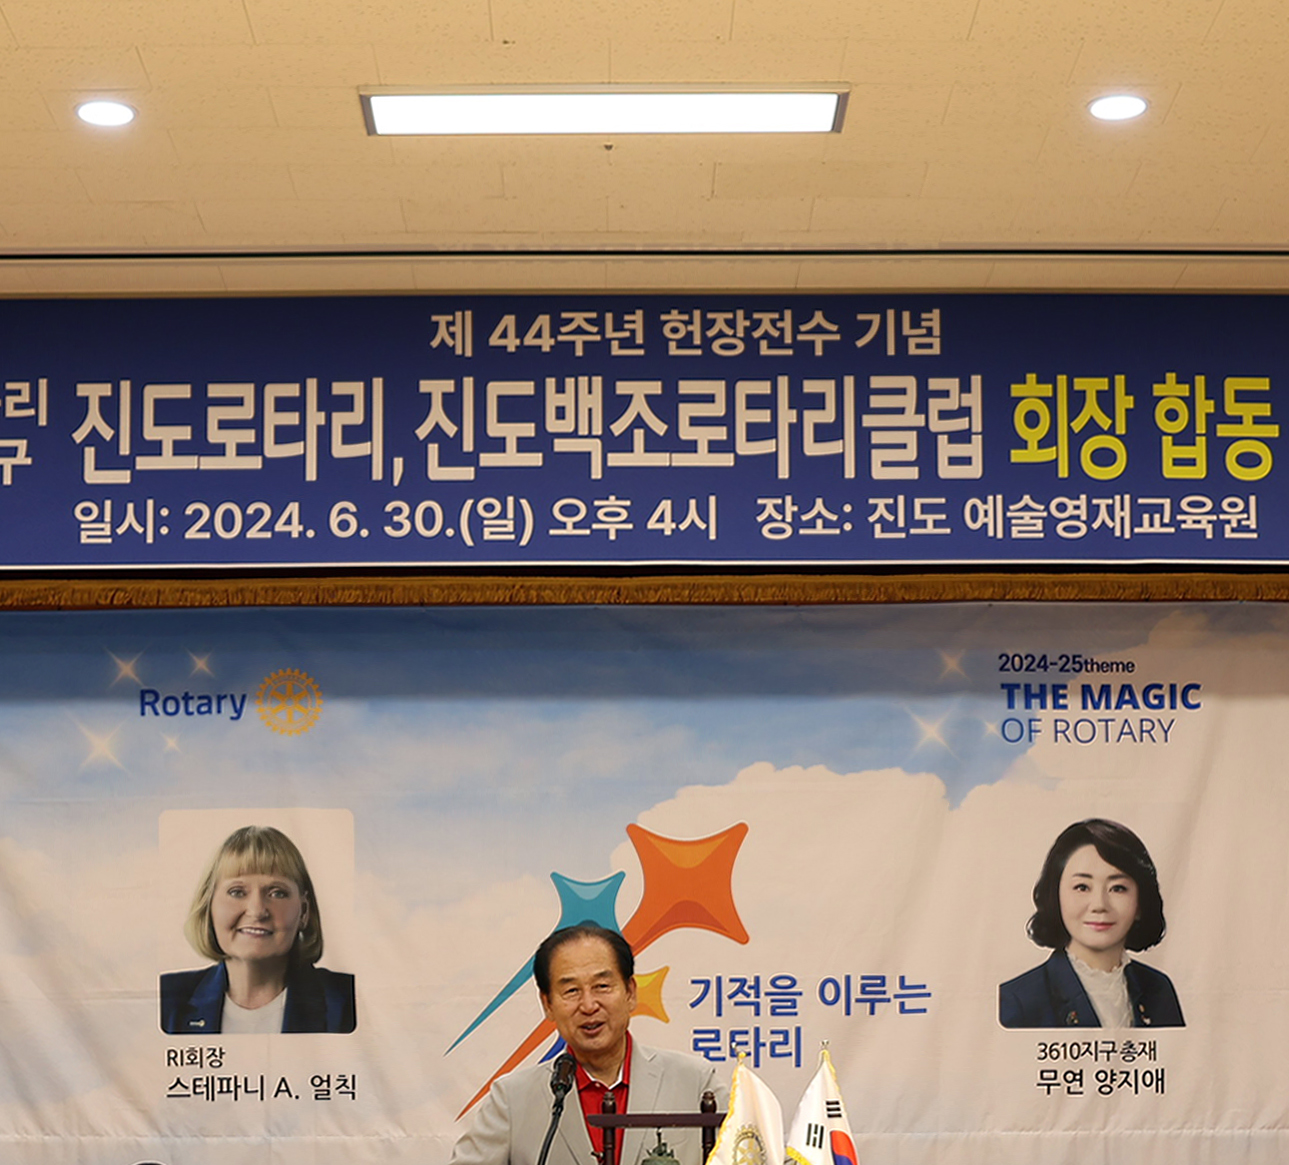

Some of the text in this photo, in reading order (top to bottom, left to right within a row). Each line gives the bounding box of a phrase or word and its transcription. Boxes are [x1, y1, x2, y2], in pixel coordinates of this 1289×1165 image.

[431, 309, 942, 357] 제 44주년 헌장전수 기념
[1009, 373, 1135, 481] 회장
[1153, 372, 1280, 481] 합동
[73, 500, 170, 544] 일시:
[183, 501, 315, 539] 2024.
[328, 501, 370, 539] 6.
[549, 496, 634, 540] 오후
[646, 496, 718, 541] 4시
[755, 495, 853, 540] 장소:
[866, 495, 952, 540] 진도
[963, 494, 1259, 540] 예술영재교육원
[139, 689, 247, 721] Rotary
[1000, 683, 1202, 710] THE MAGIC
[1001, 718, 1175, 744] OF ROTARY
[689, 974, 932, 1017] 기적을 이루는
[166, 1047, 226, 1068] RI회장
[166, 1074, 357, 1101] 스테파니 A. 얼칙
[1036, 1068, 1165, 1095] 무연 양지애
